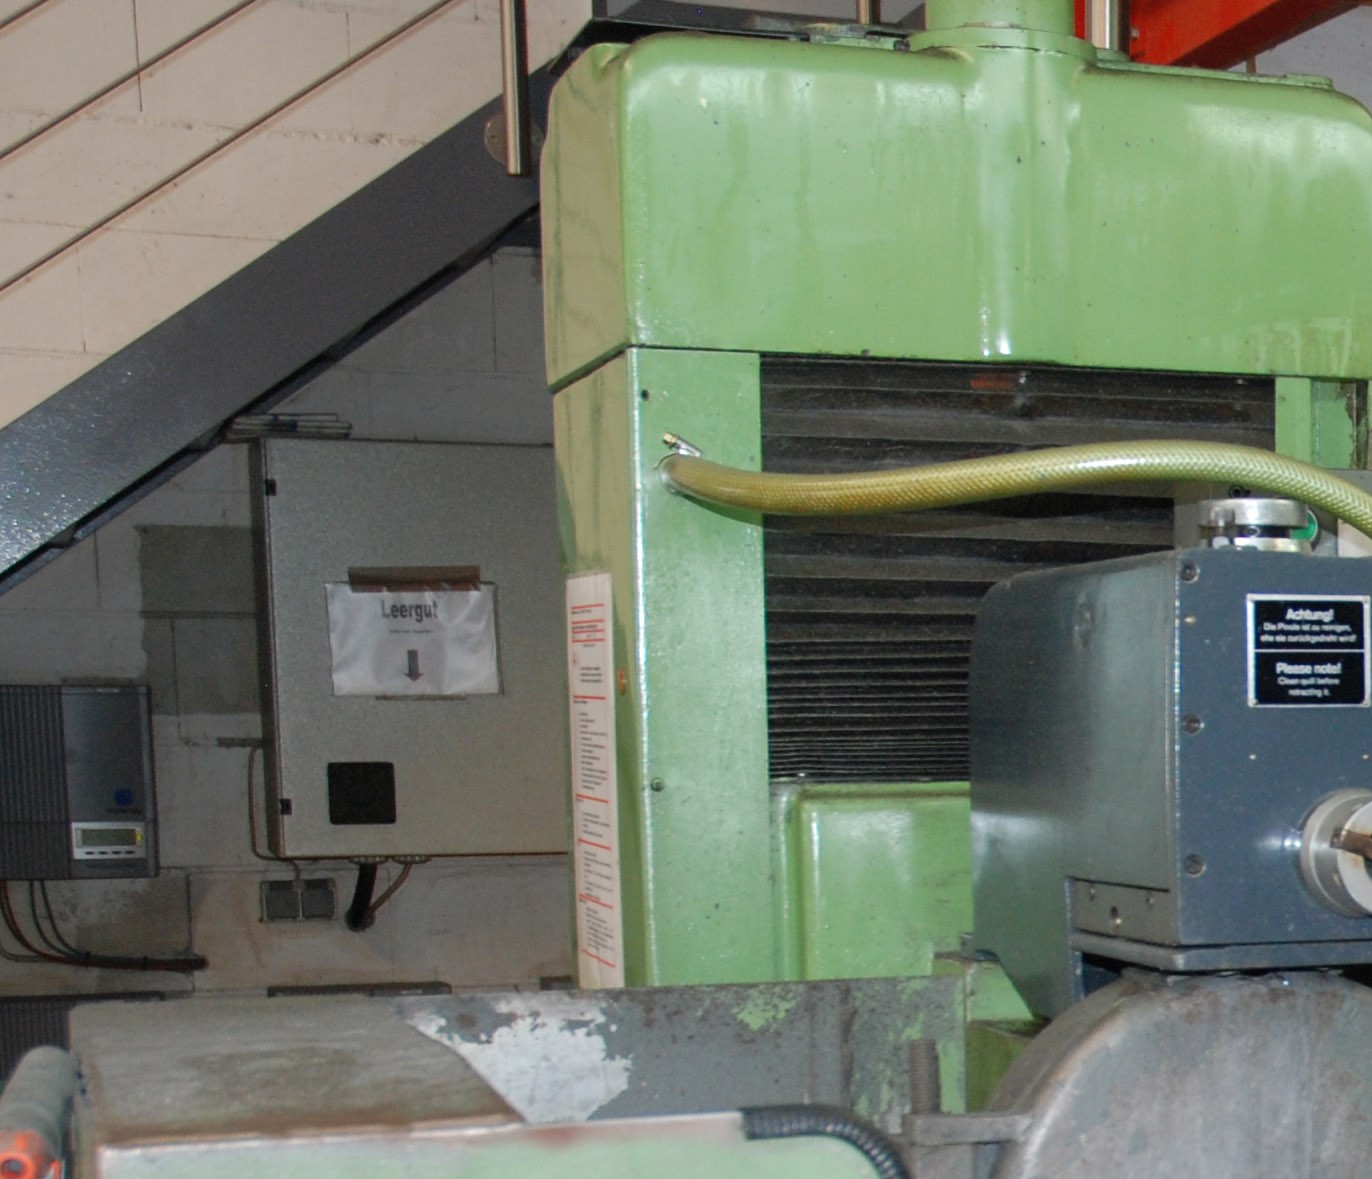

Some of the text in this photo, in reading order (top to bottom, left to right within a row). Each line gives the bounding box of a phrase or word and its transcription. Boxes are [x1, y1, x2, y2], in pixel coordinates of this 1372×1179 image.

[382, 600, 438, 623] Leergut
[1285, 608, 1334, 622] Achtung!
[1276, 662, 1342, 674] Please note!
